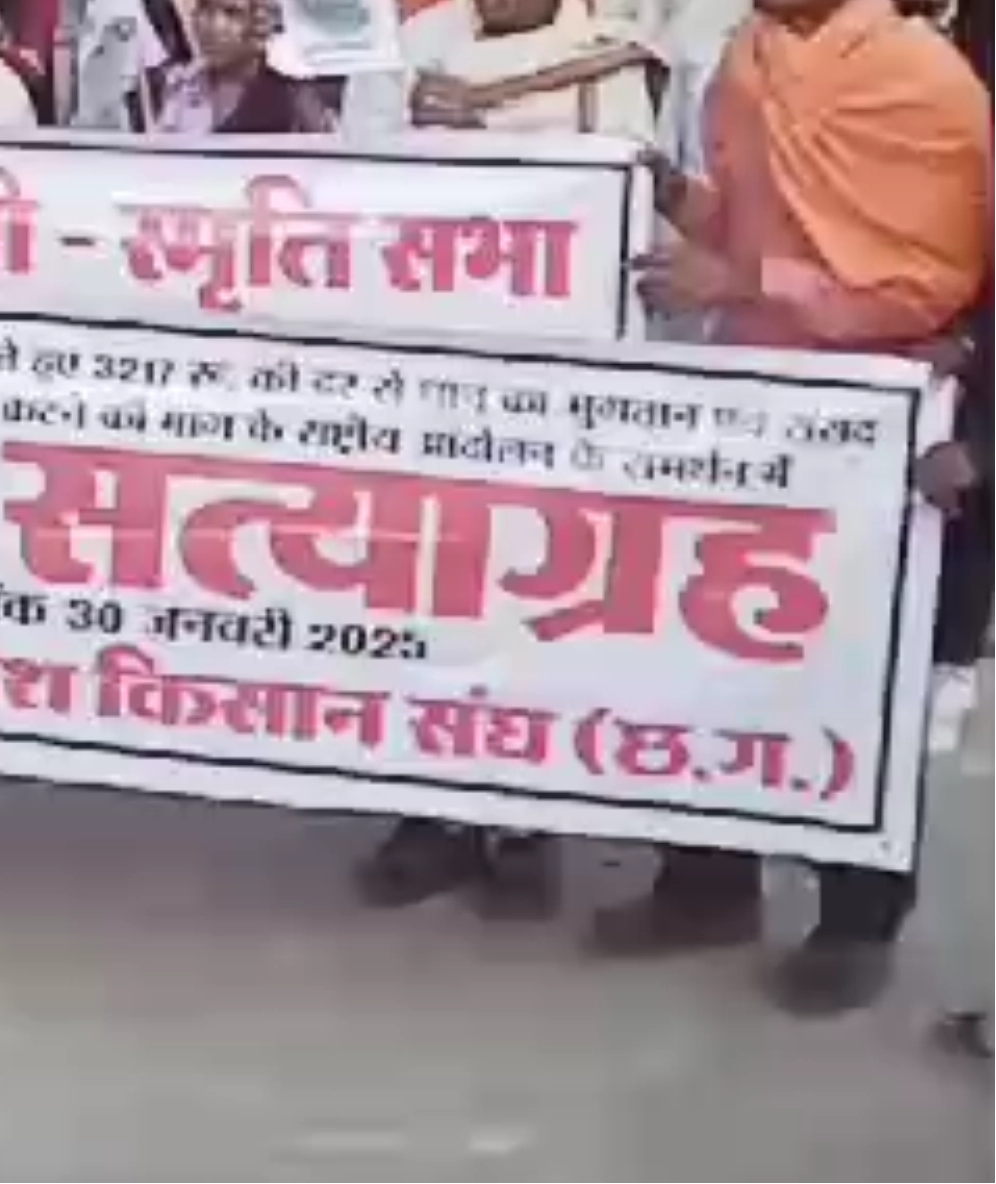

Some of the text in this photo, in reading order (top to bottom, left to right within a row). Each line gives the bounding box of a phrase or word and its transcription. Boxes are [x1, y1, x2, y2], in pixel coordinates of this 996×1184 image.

[380, 214, 578, 299] सभा
[92, 353, 175, 386] 3217
[0, 440, 838, 664] सत्याग्रह
[67, 598, 123, 634] 30
[147, 605, 294, 652] जनवरी
[309, 622, 430, 659] 2025
[94, 646, 393, 751] किसान
[406, 685, 560, 764] संघ
[573, 706, 857, 800] (छ.ग.)
